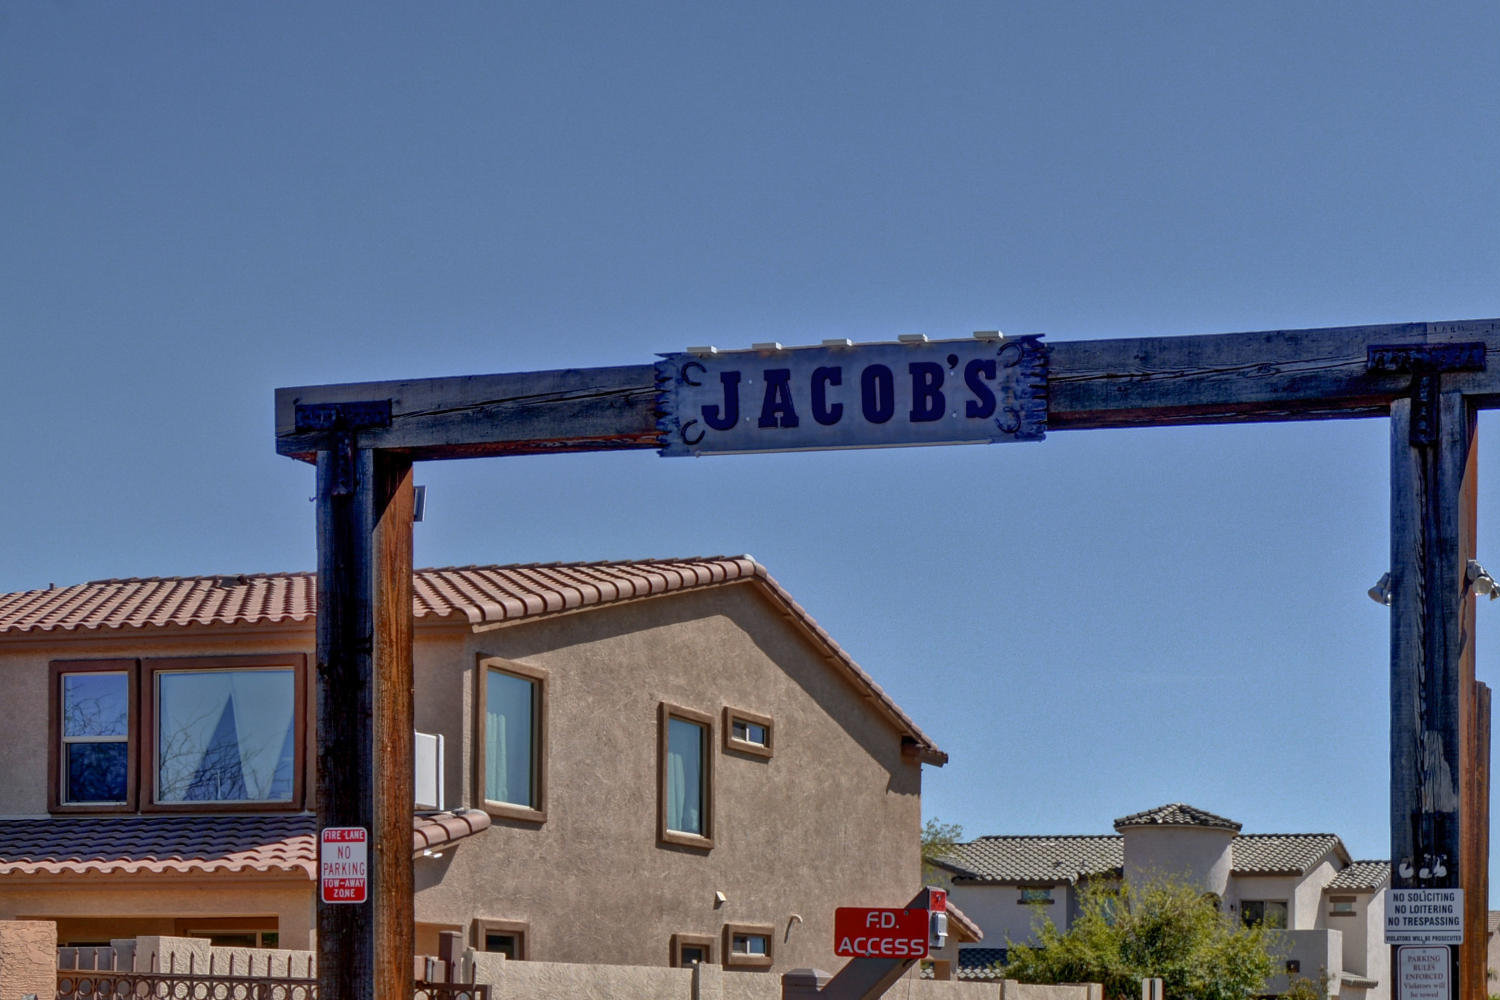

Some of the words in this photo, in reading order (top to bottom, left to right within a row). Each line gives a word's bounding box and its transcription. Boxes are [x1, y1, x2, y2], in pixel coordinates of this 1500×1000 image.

[701, 353, 997, 431] JACOB'S
[324, 830, 341, 840] FIRE
[345, 830, 364, 840] LANE
[337, 845, 351, 859] NO
[323, 862, 365, 876] PARKING
[324, 879, 364, 888] TOW-AWAY
[333, 888, 356, 898] ZONE
[1393, 892, 1405, 902] NO
[1407, 892, 1455, 902] SOLICITING
[1394, 905, 1407, 914] NO
[1409, 905, 1453, 914] LOITERING
[866, 911, 900, 929] F.D.
[1388, 917, 1400, 926] NO
[1402, 917, 1460, 926] TRESPASSING
[838, 937, 925, 955] ACCESS
